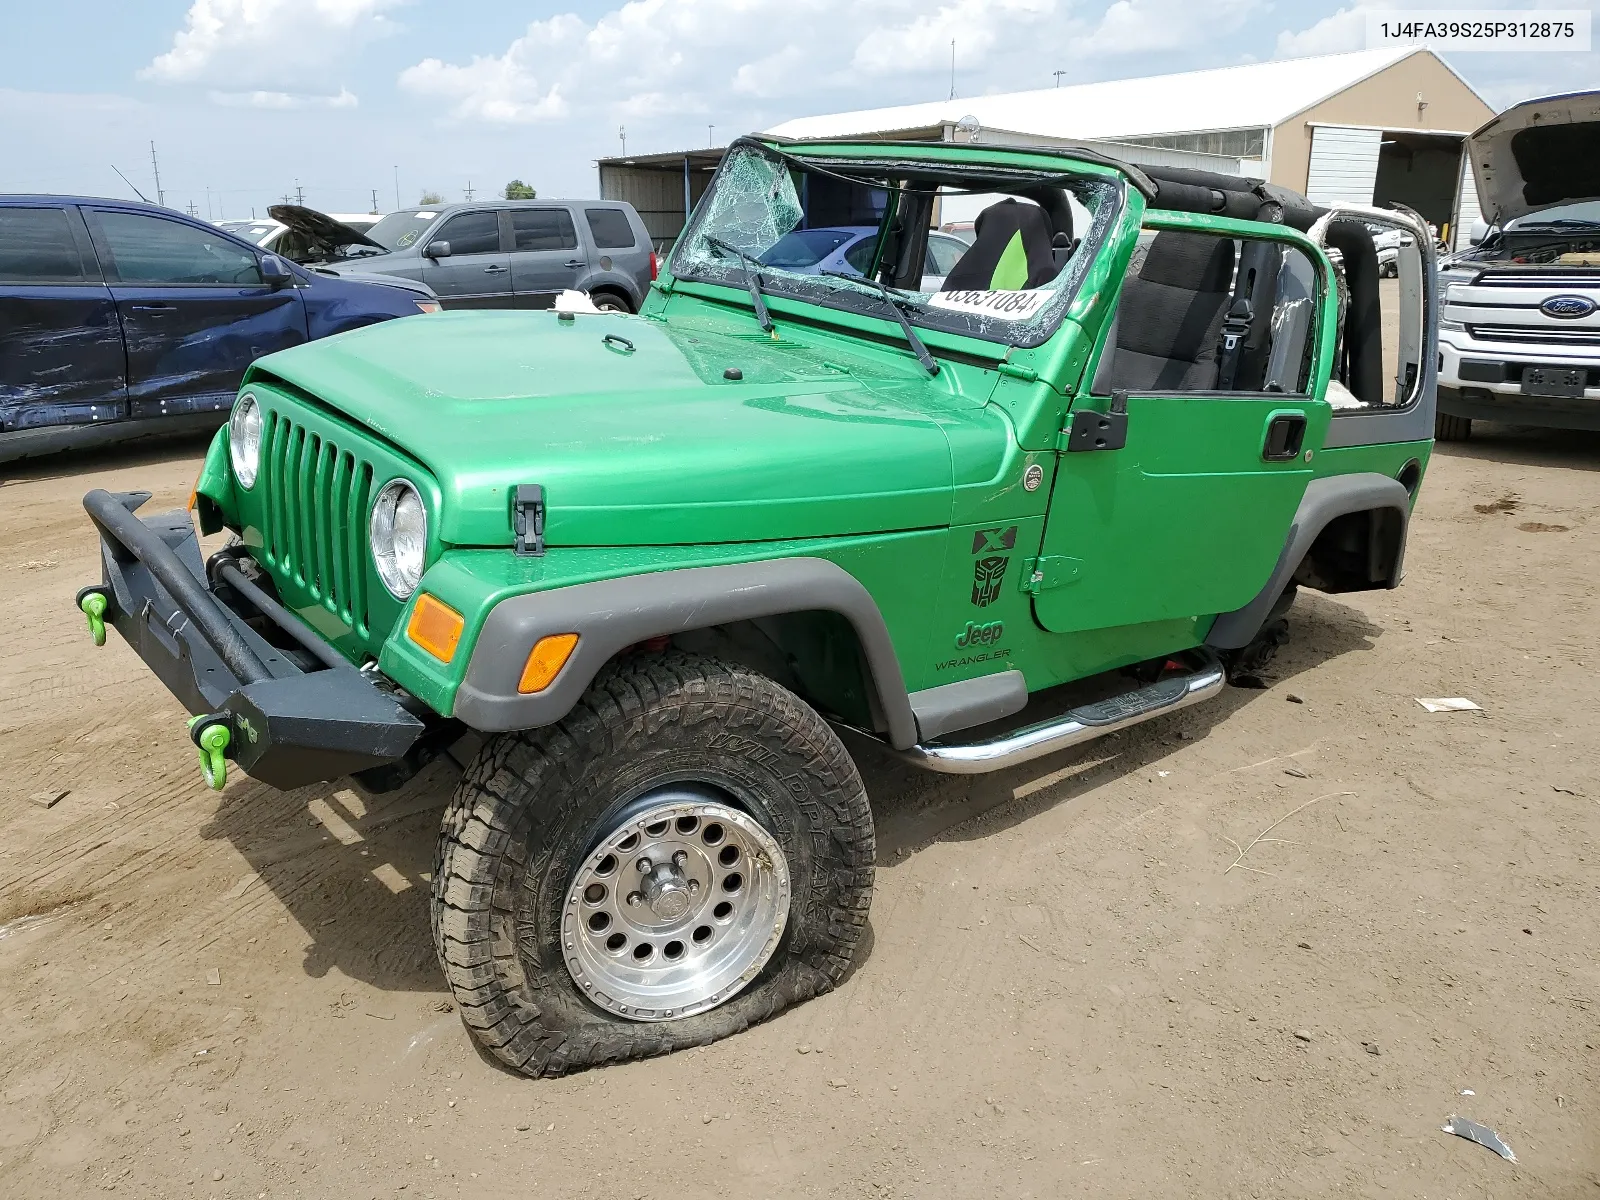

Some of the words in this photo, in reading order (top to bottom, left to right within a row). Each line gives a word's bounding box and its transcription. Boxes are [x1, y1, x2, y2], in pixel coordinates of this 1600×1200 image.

[1553, 301, 1580, 312] Ford
[956, 621, 1004, 649] Jeep
[934, 648, 1012, 672] WRANGLER
